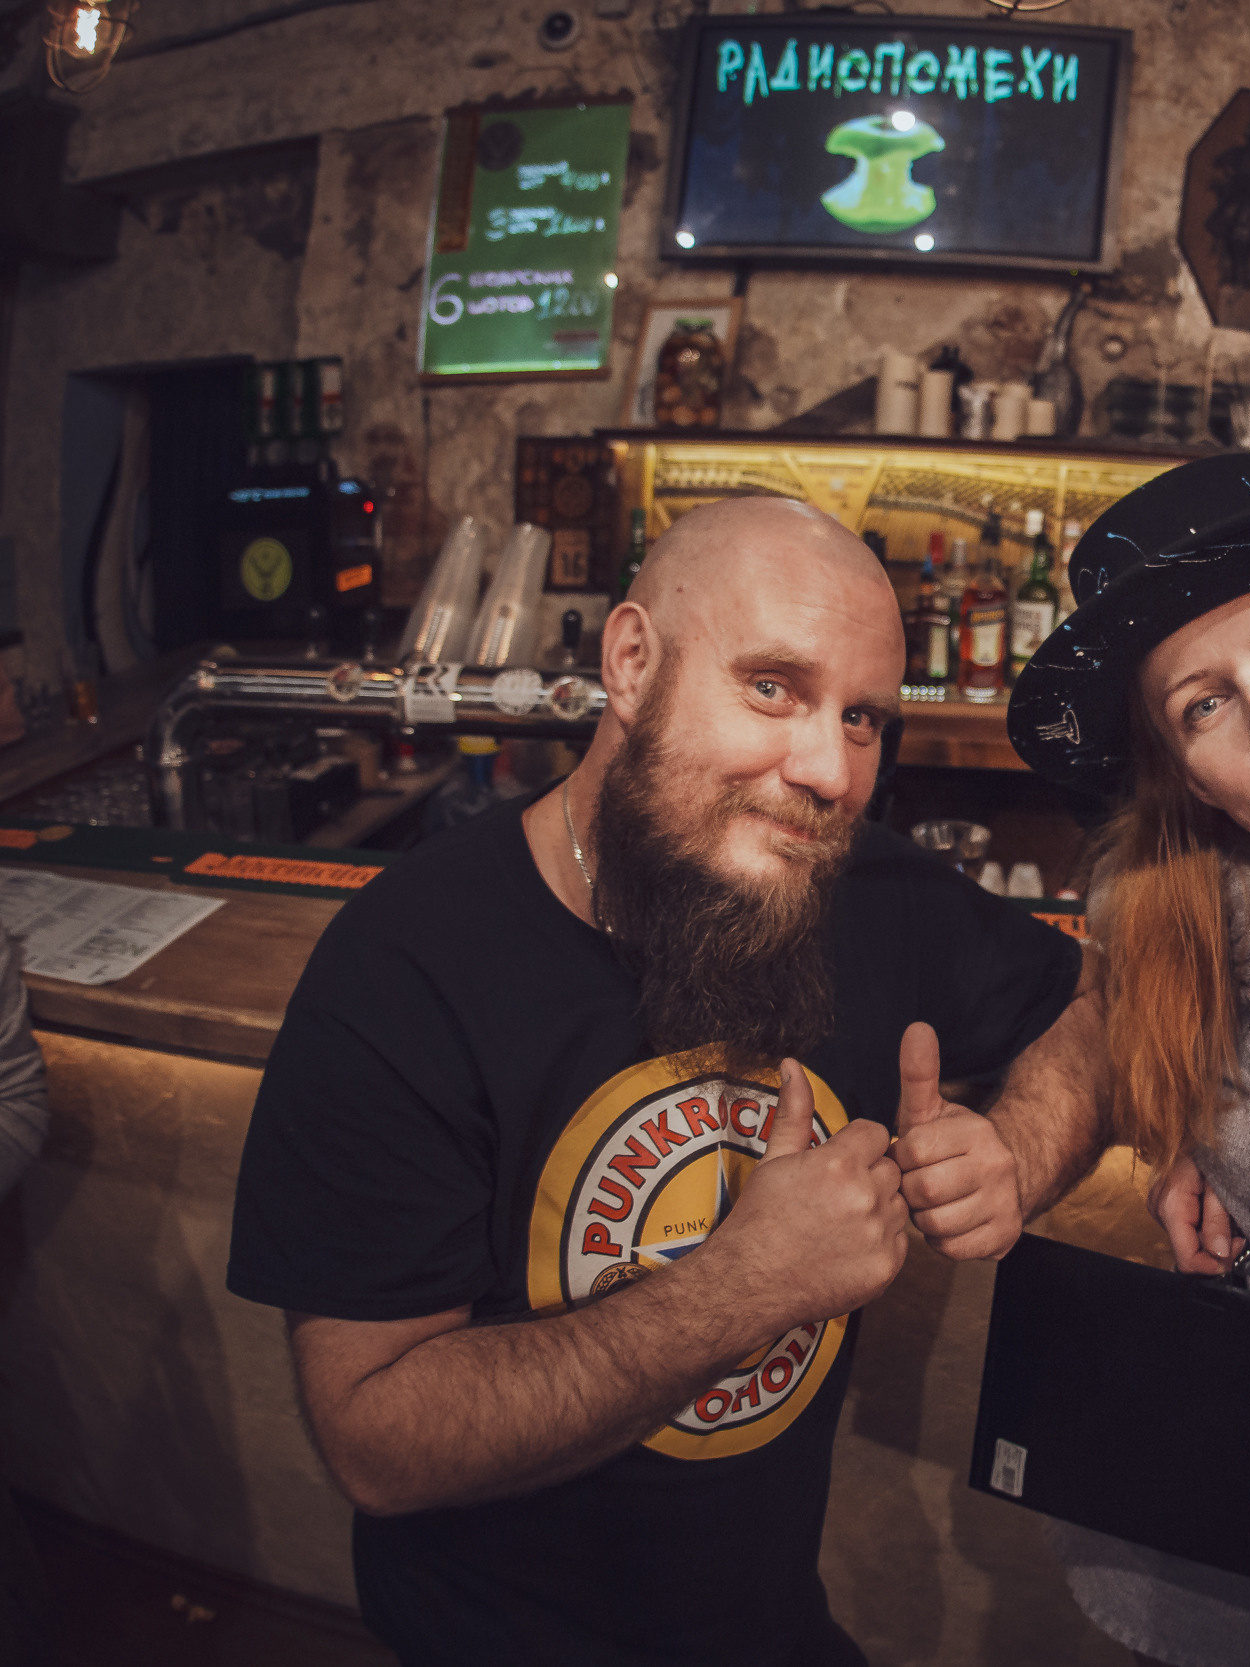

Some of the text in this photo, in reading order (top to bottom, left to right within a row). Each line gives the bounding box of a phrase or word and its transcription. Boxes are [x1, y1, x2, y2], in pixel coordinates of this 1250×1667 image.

[716, 37, 1079, 105] РАДИОПОМЕХИ
[429, 272, 464, 325] 6
[663, 1218, 710, 1238] PUNK
